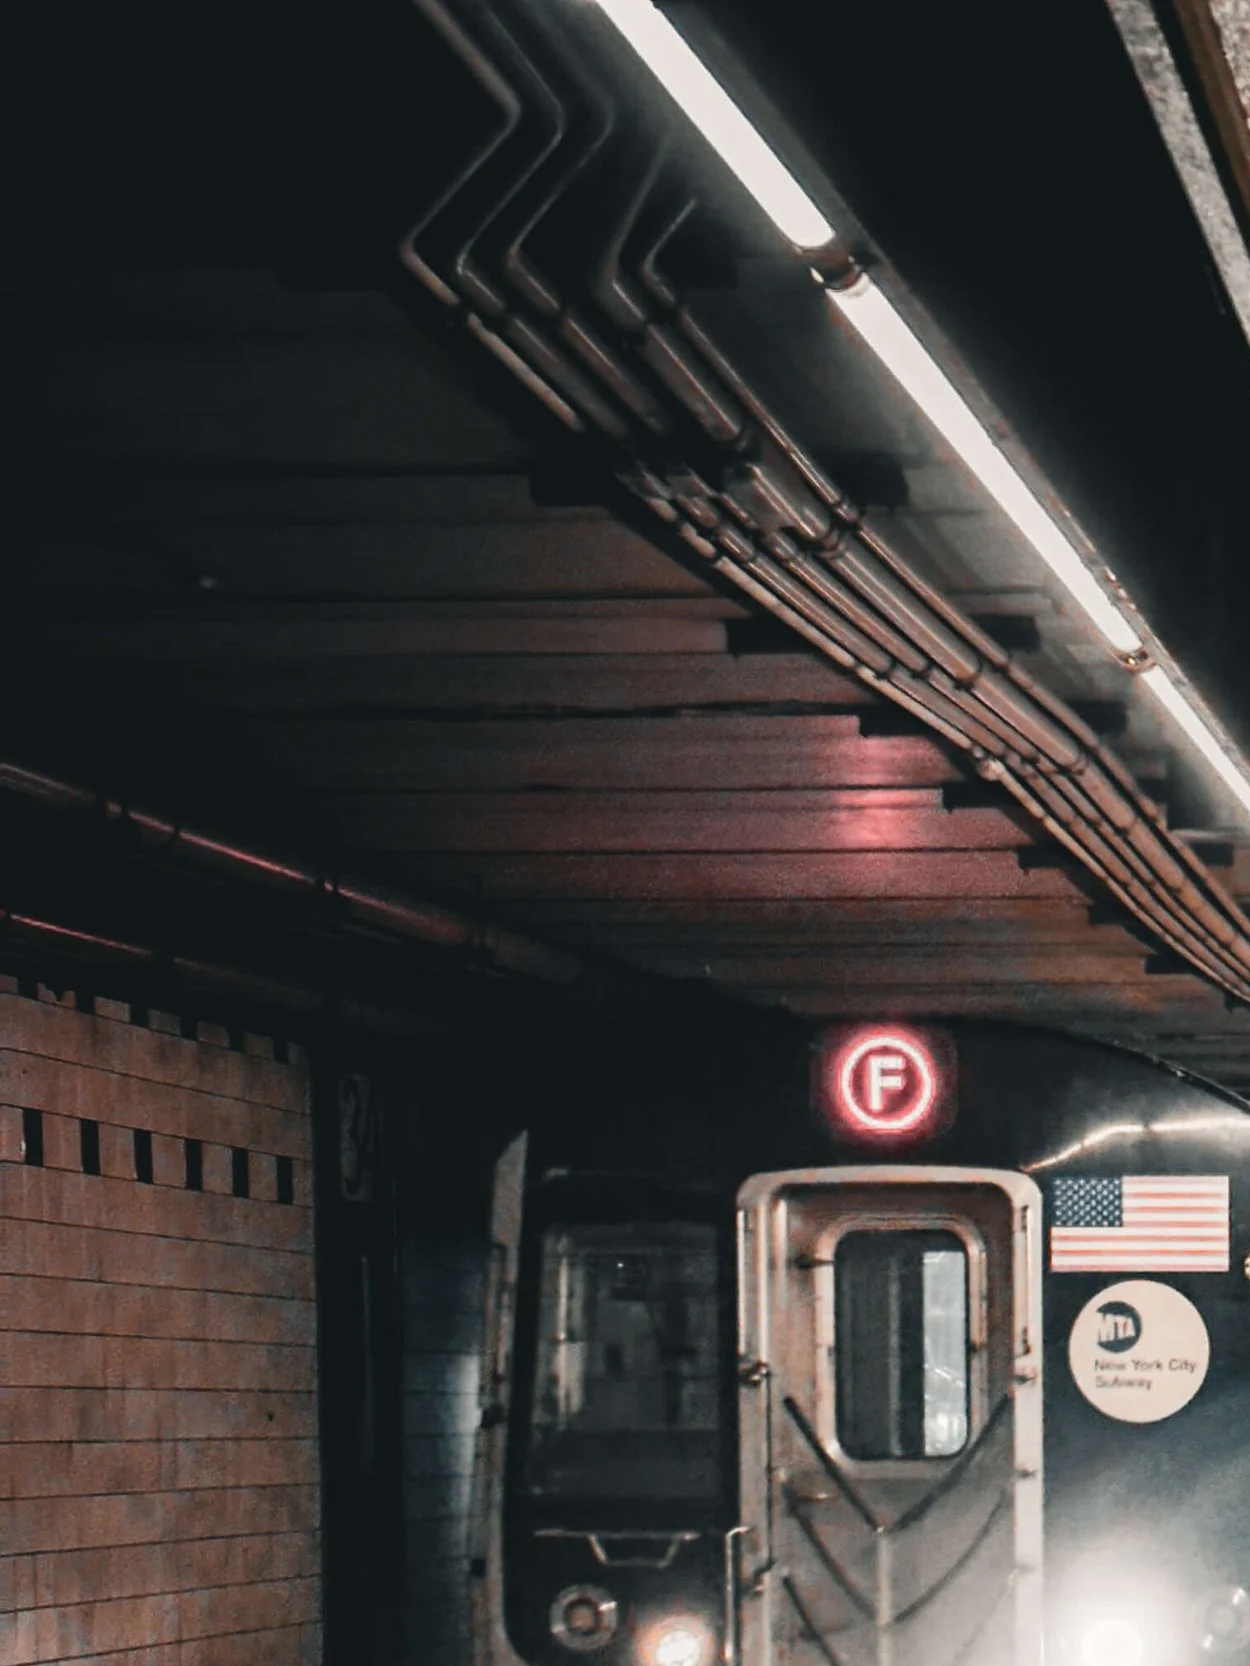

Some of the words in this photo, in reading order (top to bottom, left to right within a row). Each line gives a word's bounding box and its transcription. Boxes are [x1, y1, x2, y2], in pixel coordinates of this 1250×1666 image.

[867, 1054, 907, 1113] F
[1095, 1359, 1126, 1371] New
[1131, 1359, 1163, 1371] York
[1168, 1358, 1196, 1374] City
[1095, 1375, 1152, 1390] Subway
